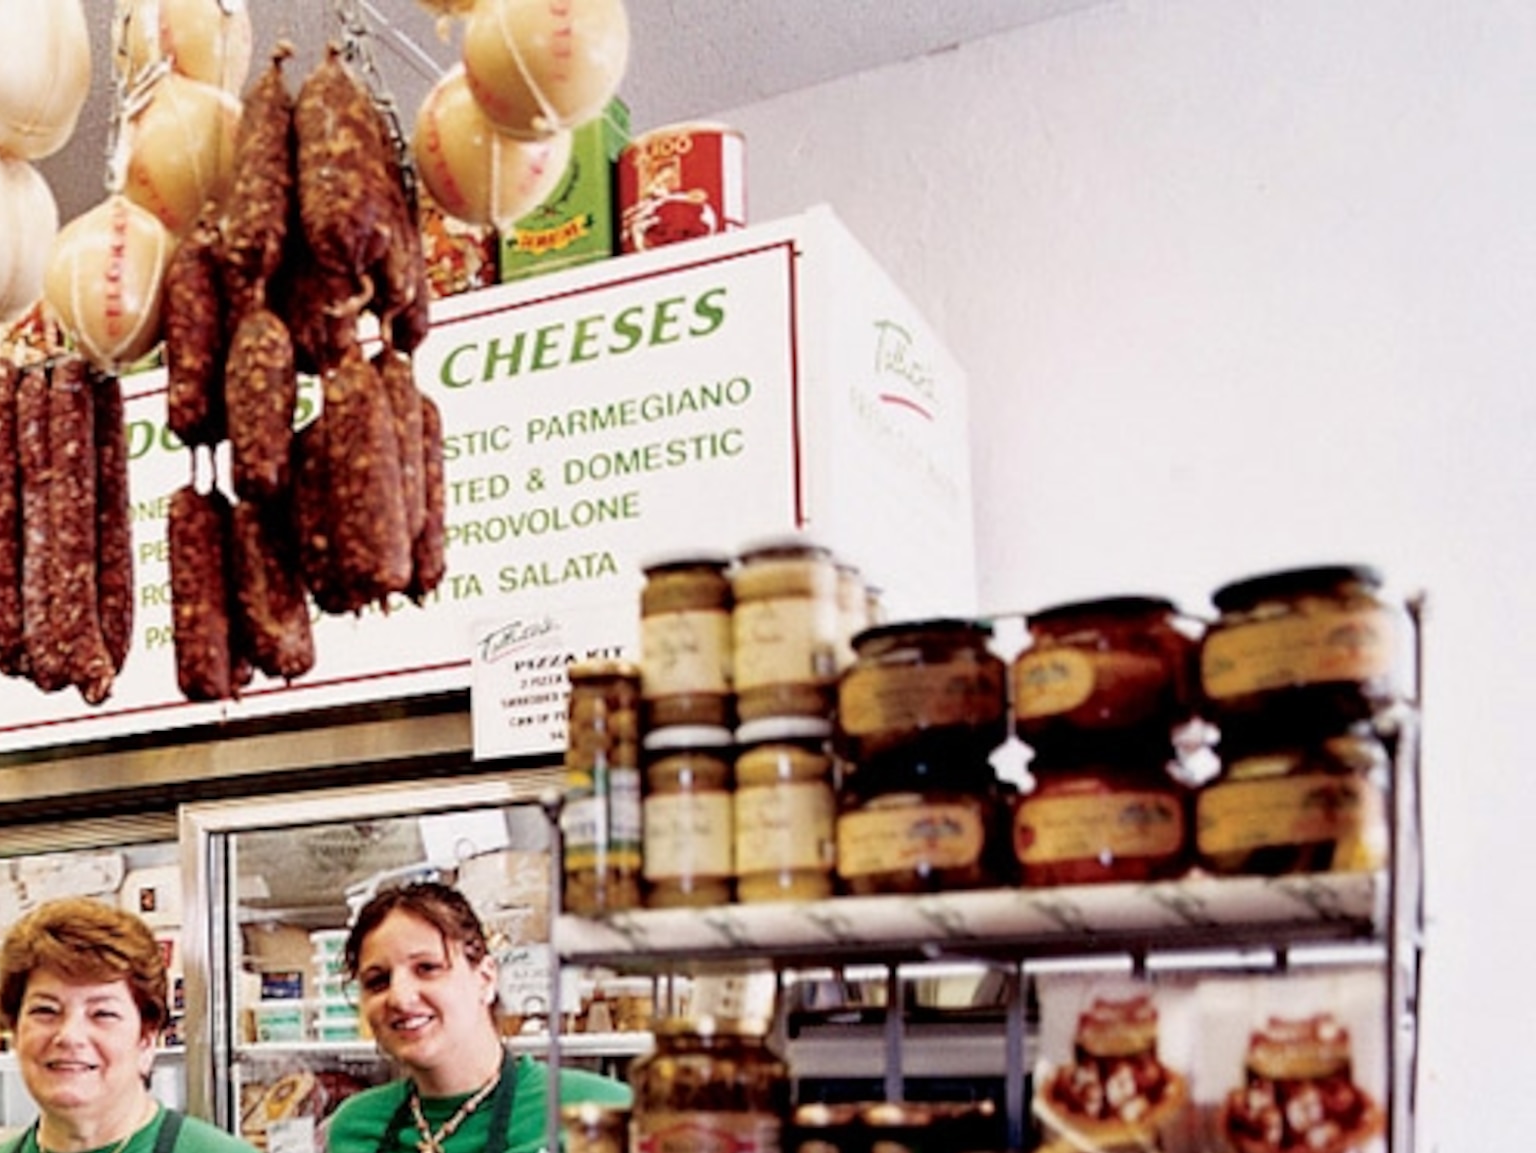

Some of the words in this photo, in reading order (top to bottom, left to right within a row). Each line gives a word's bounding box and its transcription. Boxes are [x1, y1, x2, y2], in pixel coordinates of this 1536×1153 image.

[439, 287, 728, 389] CHEESES
[442, 425, 511, 460] STIC
[527, 377, 752, 444] PARMEGIANO
[450, 474, 510, 506] TED
[526, 468, 546, 493] &
[563, 428, 746, 486] DOMESTIC
[443, 492, 642, 549] PROVOLONE
[498, 552, 619, 594] SALATA
